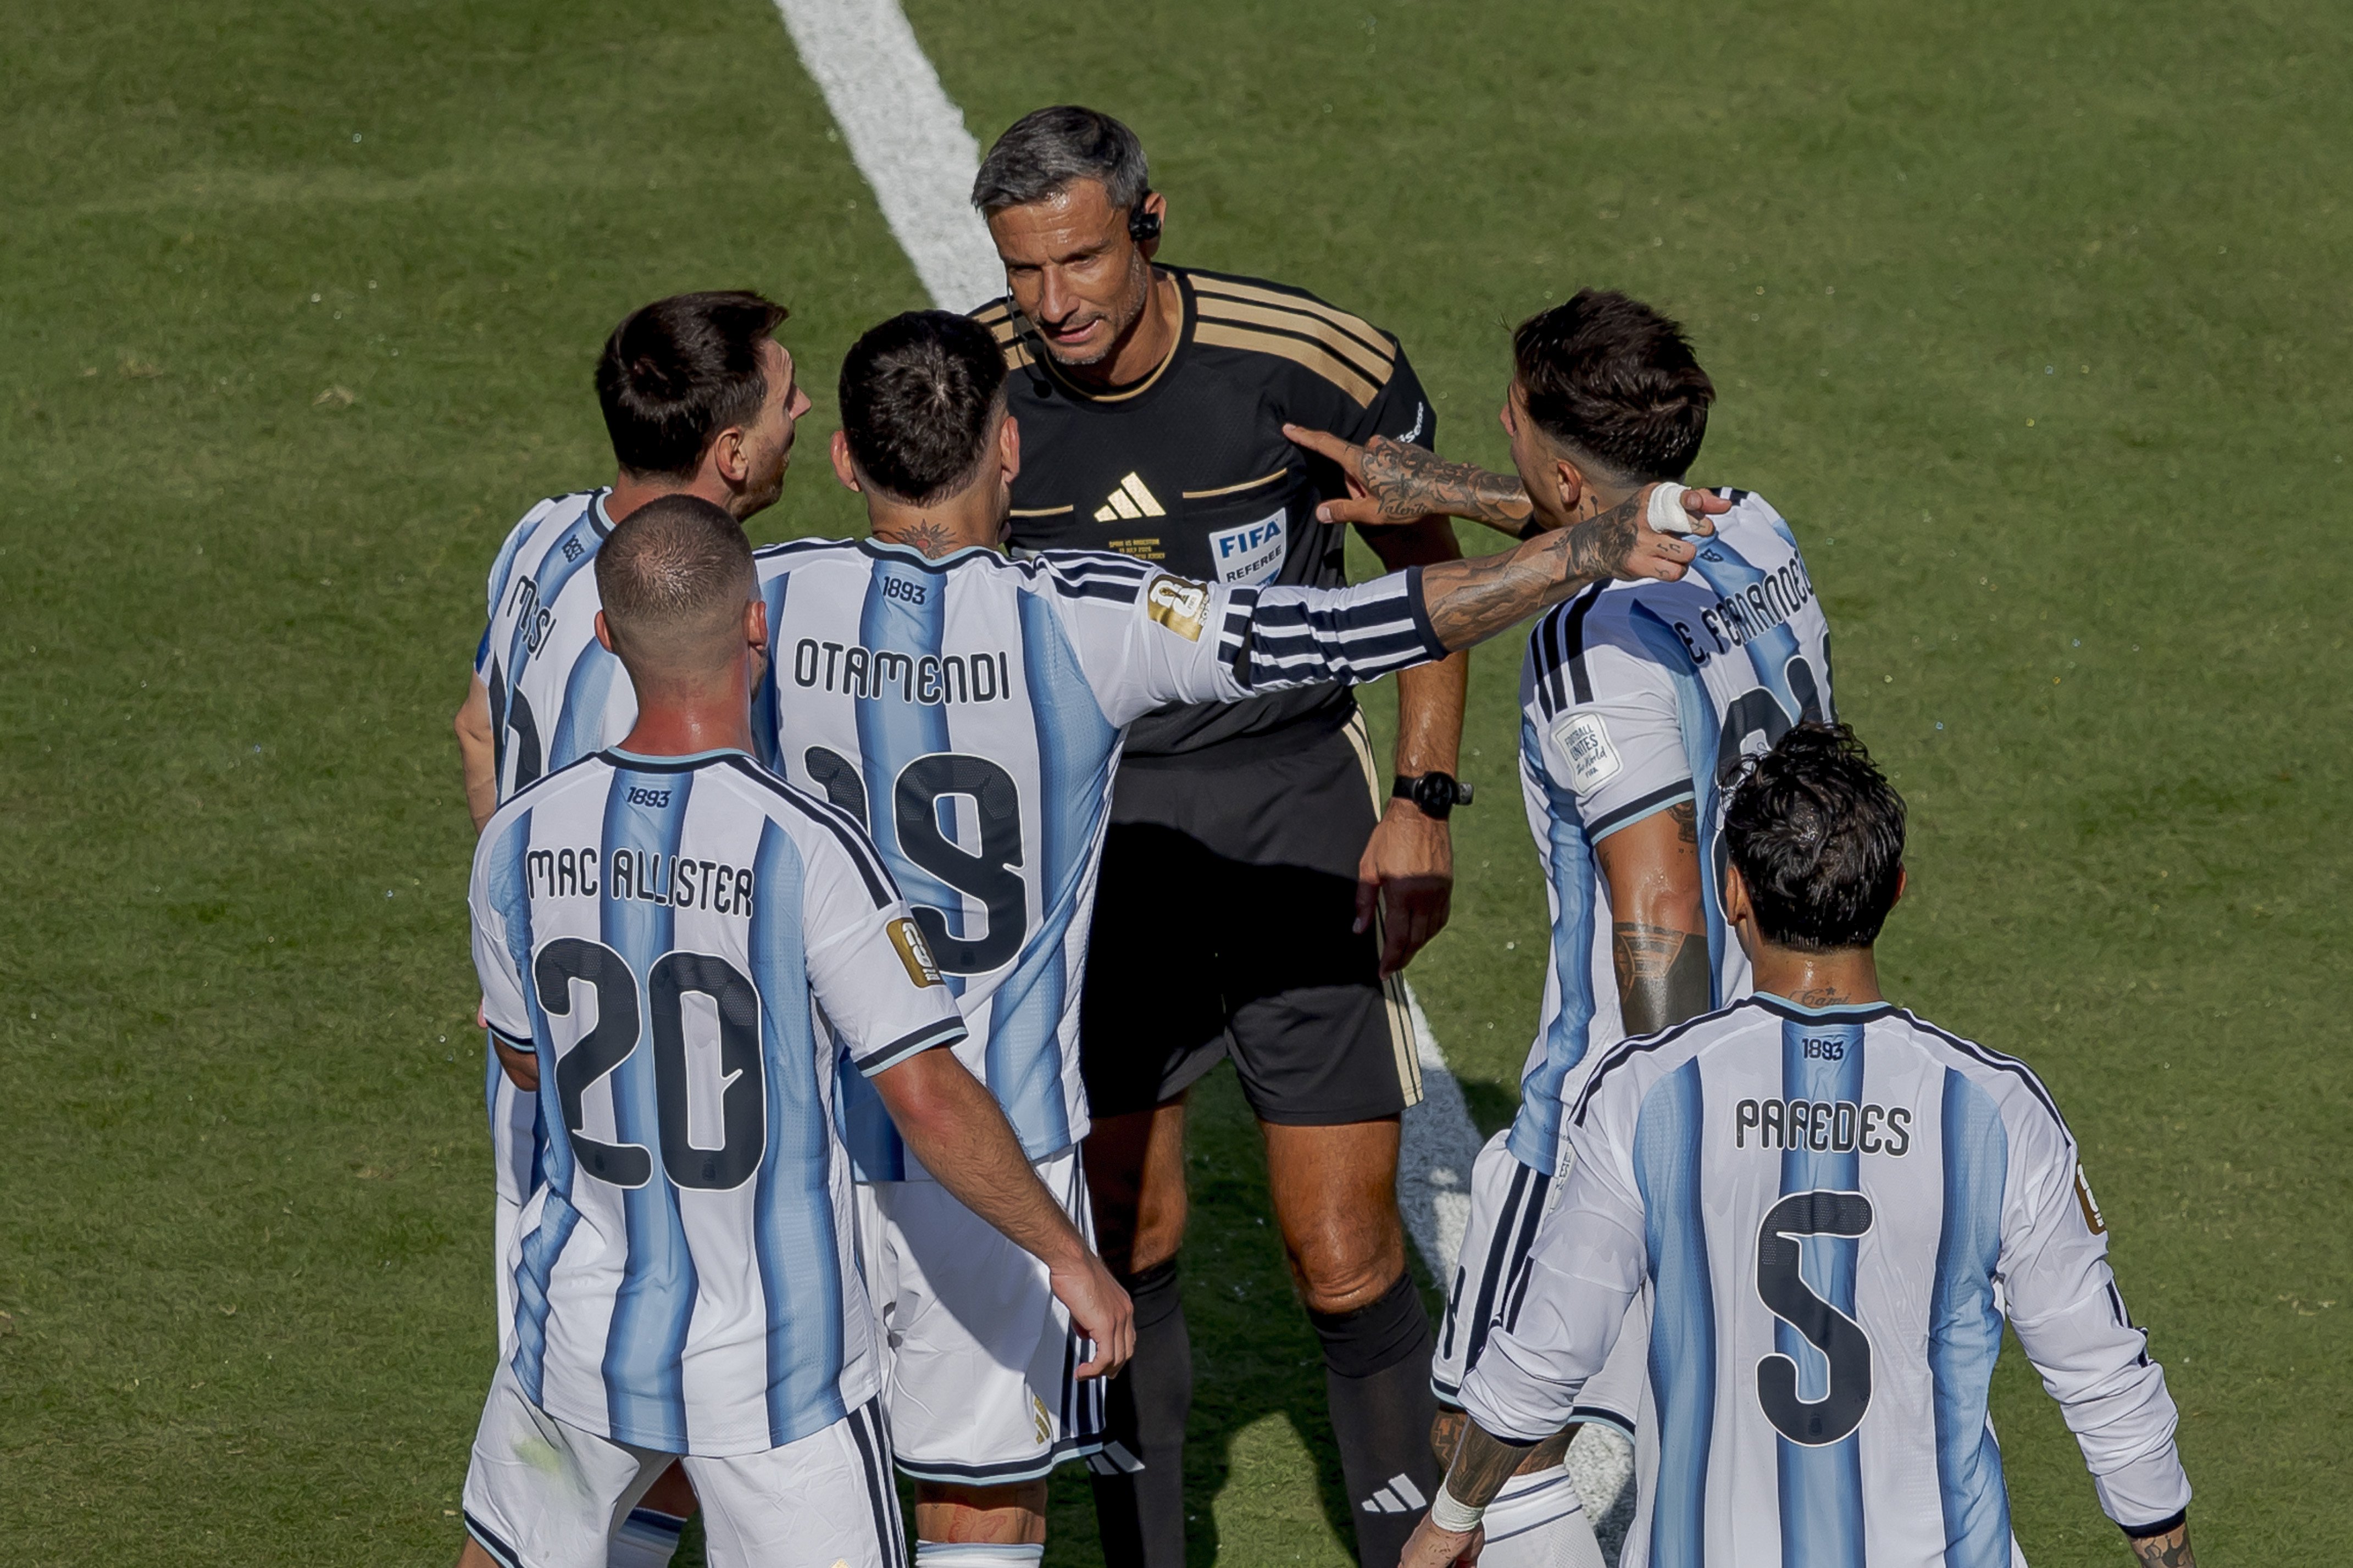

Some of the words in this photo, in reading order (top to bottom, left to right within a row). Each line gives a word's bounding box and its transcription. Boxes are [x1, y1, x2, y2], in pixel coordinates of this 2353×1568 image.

[1219, 520, 1281, 559] FIFA
[1226, 545, 1282, 582] REFEREE
[883, 576, 927, 605] 1893
[1674, 621, 1712, 665] E.
[794, 637, 1012, 705] OTAMENDI
[1570, 733, 1599, 761] UNITES
[626, 786, 673, 809] 1893
[528, 848, 598, 899] MAC
[612, 849, 754, 918] ALLISTER
[532, 937, 767, 1191] 20
[1801, 1038, 1844, 1061] 1893
[1735, 1098, 1912, 1157] PAREDES
[1755, 1190, 1873, 1447] 5
